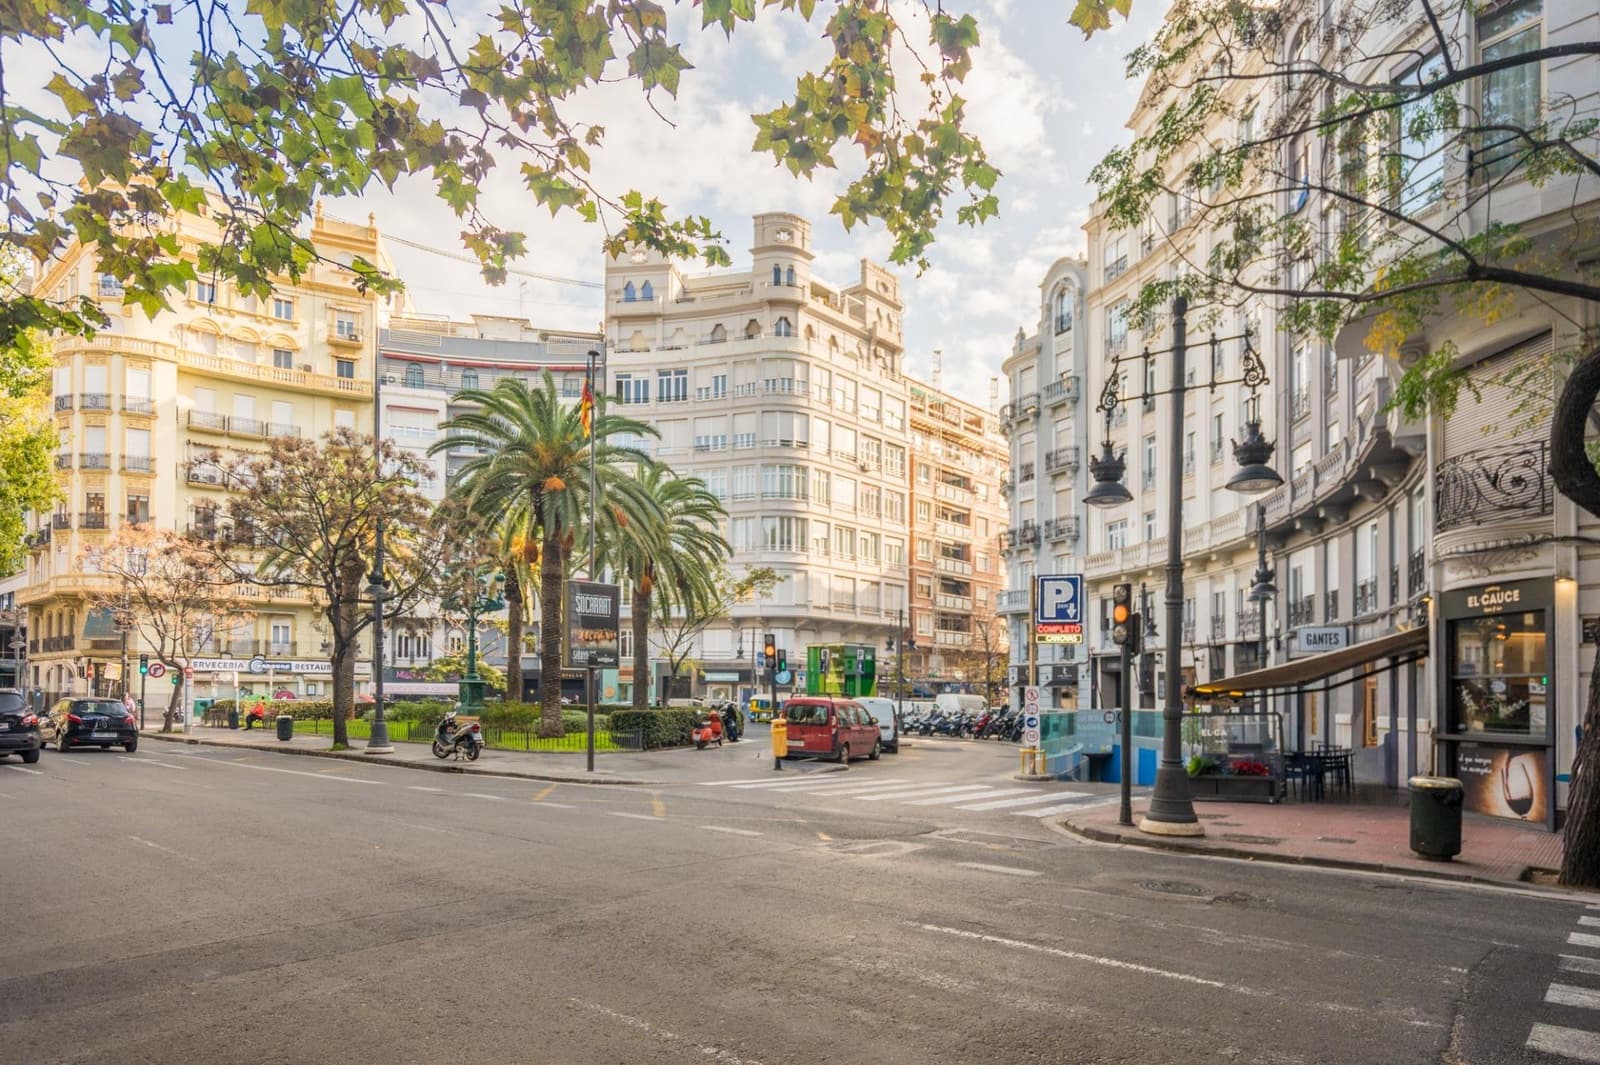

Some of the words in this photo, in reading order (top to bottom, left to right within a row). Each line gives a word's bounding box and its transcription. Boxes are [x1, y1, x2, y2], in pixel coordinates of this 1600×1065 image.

[1044, 580, 1074, 618] P
[1467, 595, 1480, 608] EL
[1481, 589, 1520, 606] CAUCE
[1037, 625, 1081, 633] COMPLETO
[1306, 633, 1340, 646] GANTES
[192, 661, 245, 669] ERVECERIA
[294, 663, 332, 671] RESTAUR
